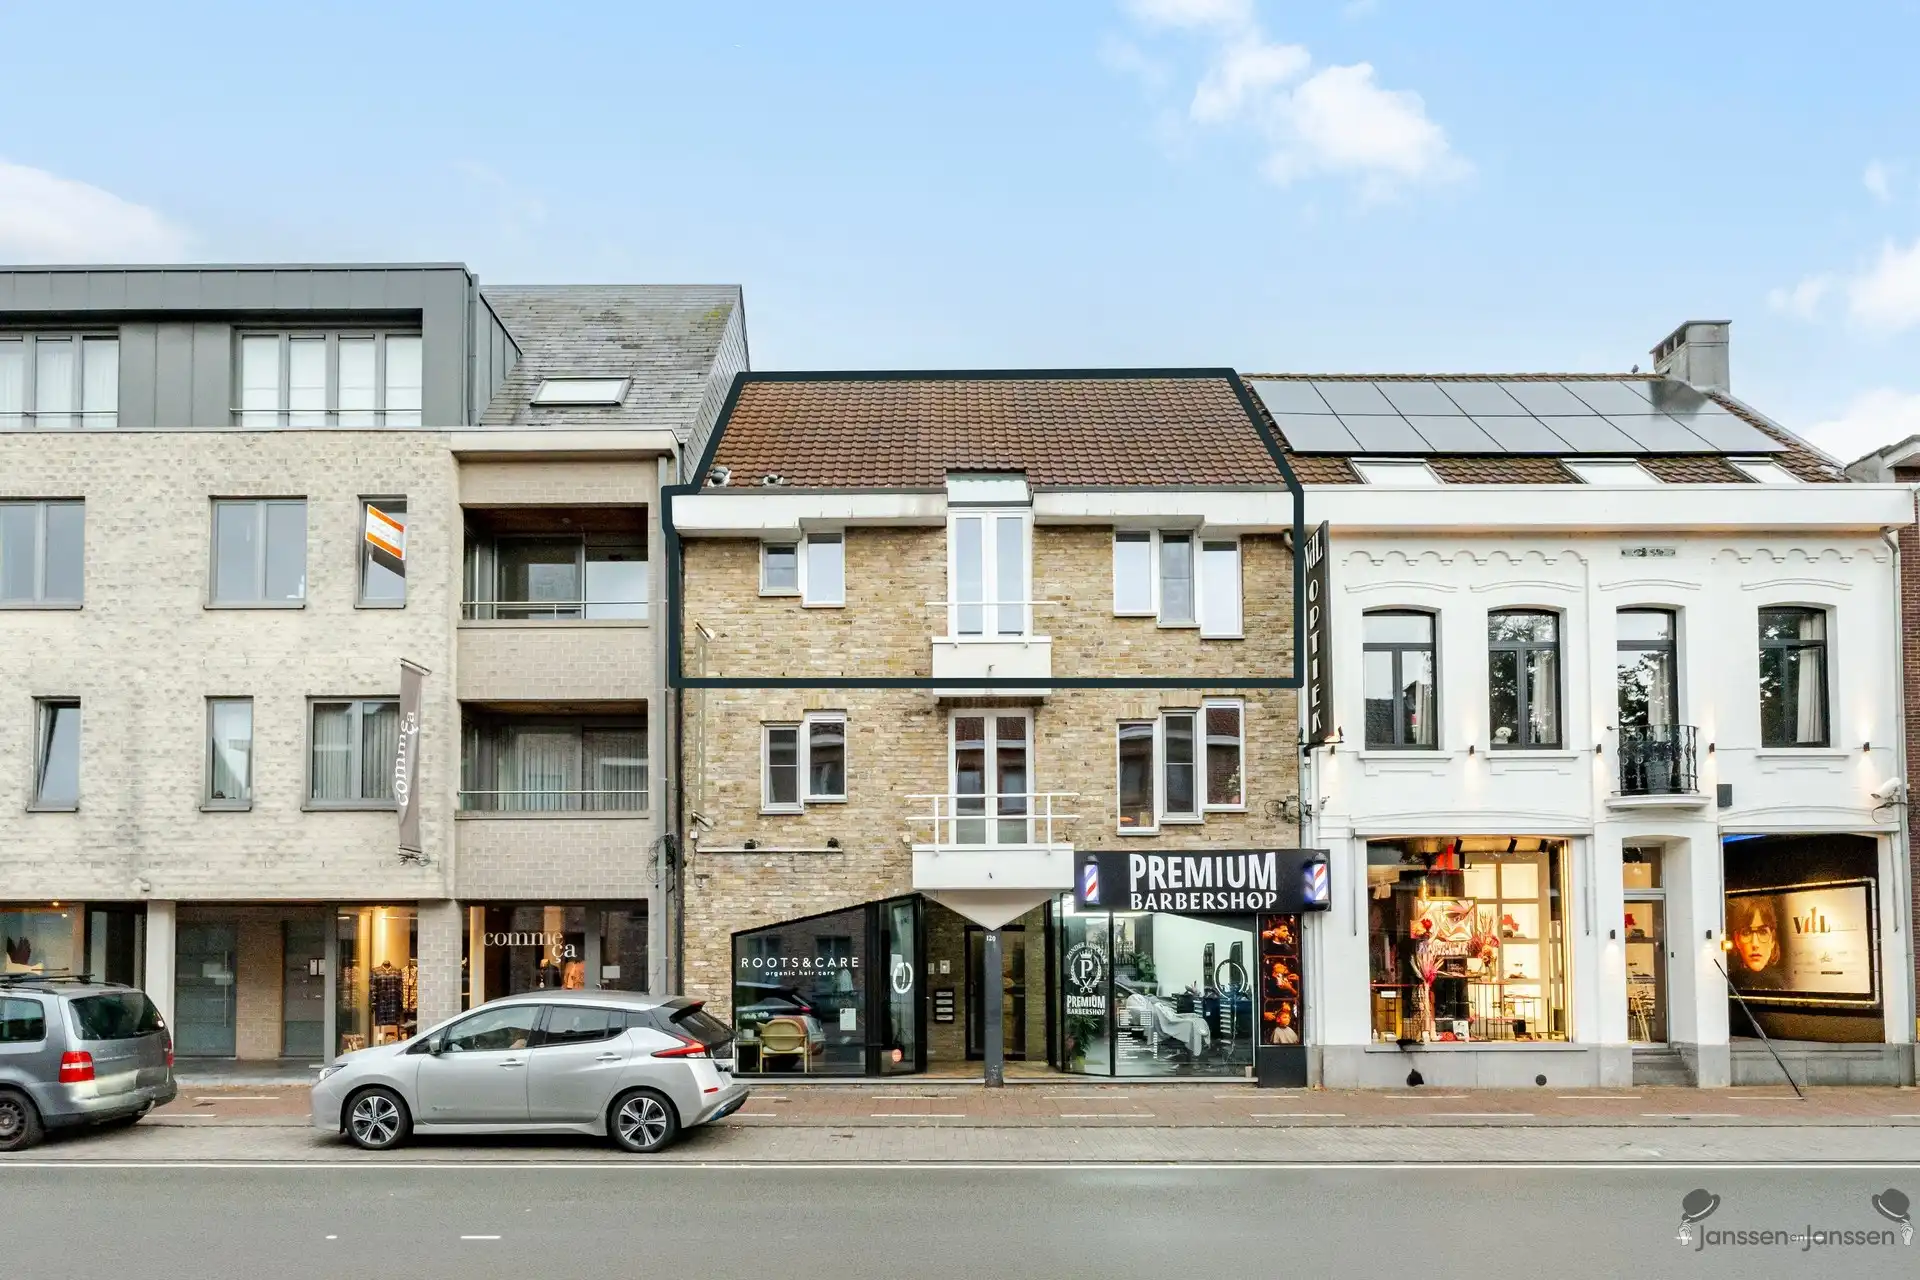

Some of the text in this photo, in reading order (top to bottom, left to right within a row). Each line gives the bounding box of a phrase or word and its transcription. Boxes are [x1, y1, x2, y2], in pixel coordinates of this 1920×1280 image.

[1308, 579, 1321, 734] OPTIEK
[406, 712, 419, 735] ça
[395, 720, 409, 807] comme
[1129, 852, 1277, 892] PREMIUM
[1130, 892, 1278, 911] BARBERSHOP
[483, 931, 563, 947] comme
[551, 943, 577, 963] ça
[741, 957, 859, 968] ROOTS&CARE
[1080, 959, 1094, 979] P
[1066, 994, 1106, 1008] PREMIUM
[1066, 1008, 1106, 1016] BARBERSHOP
